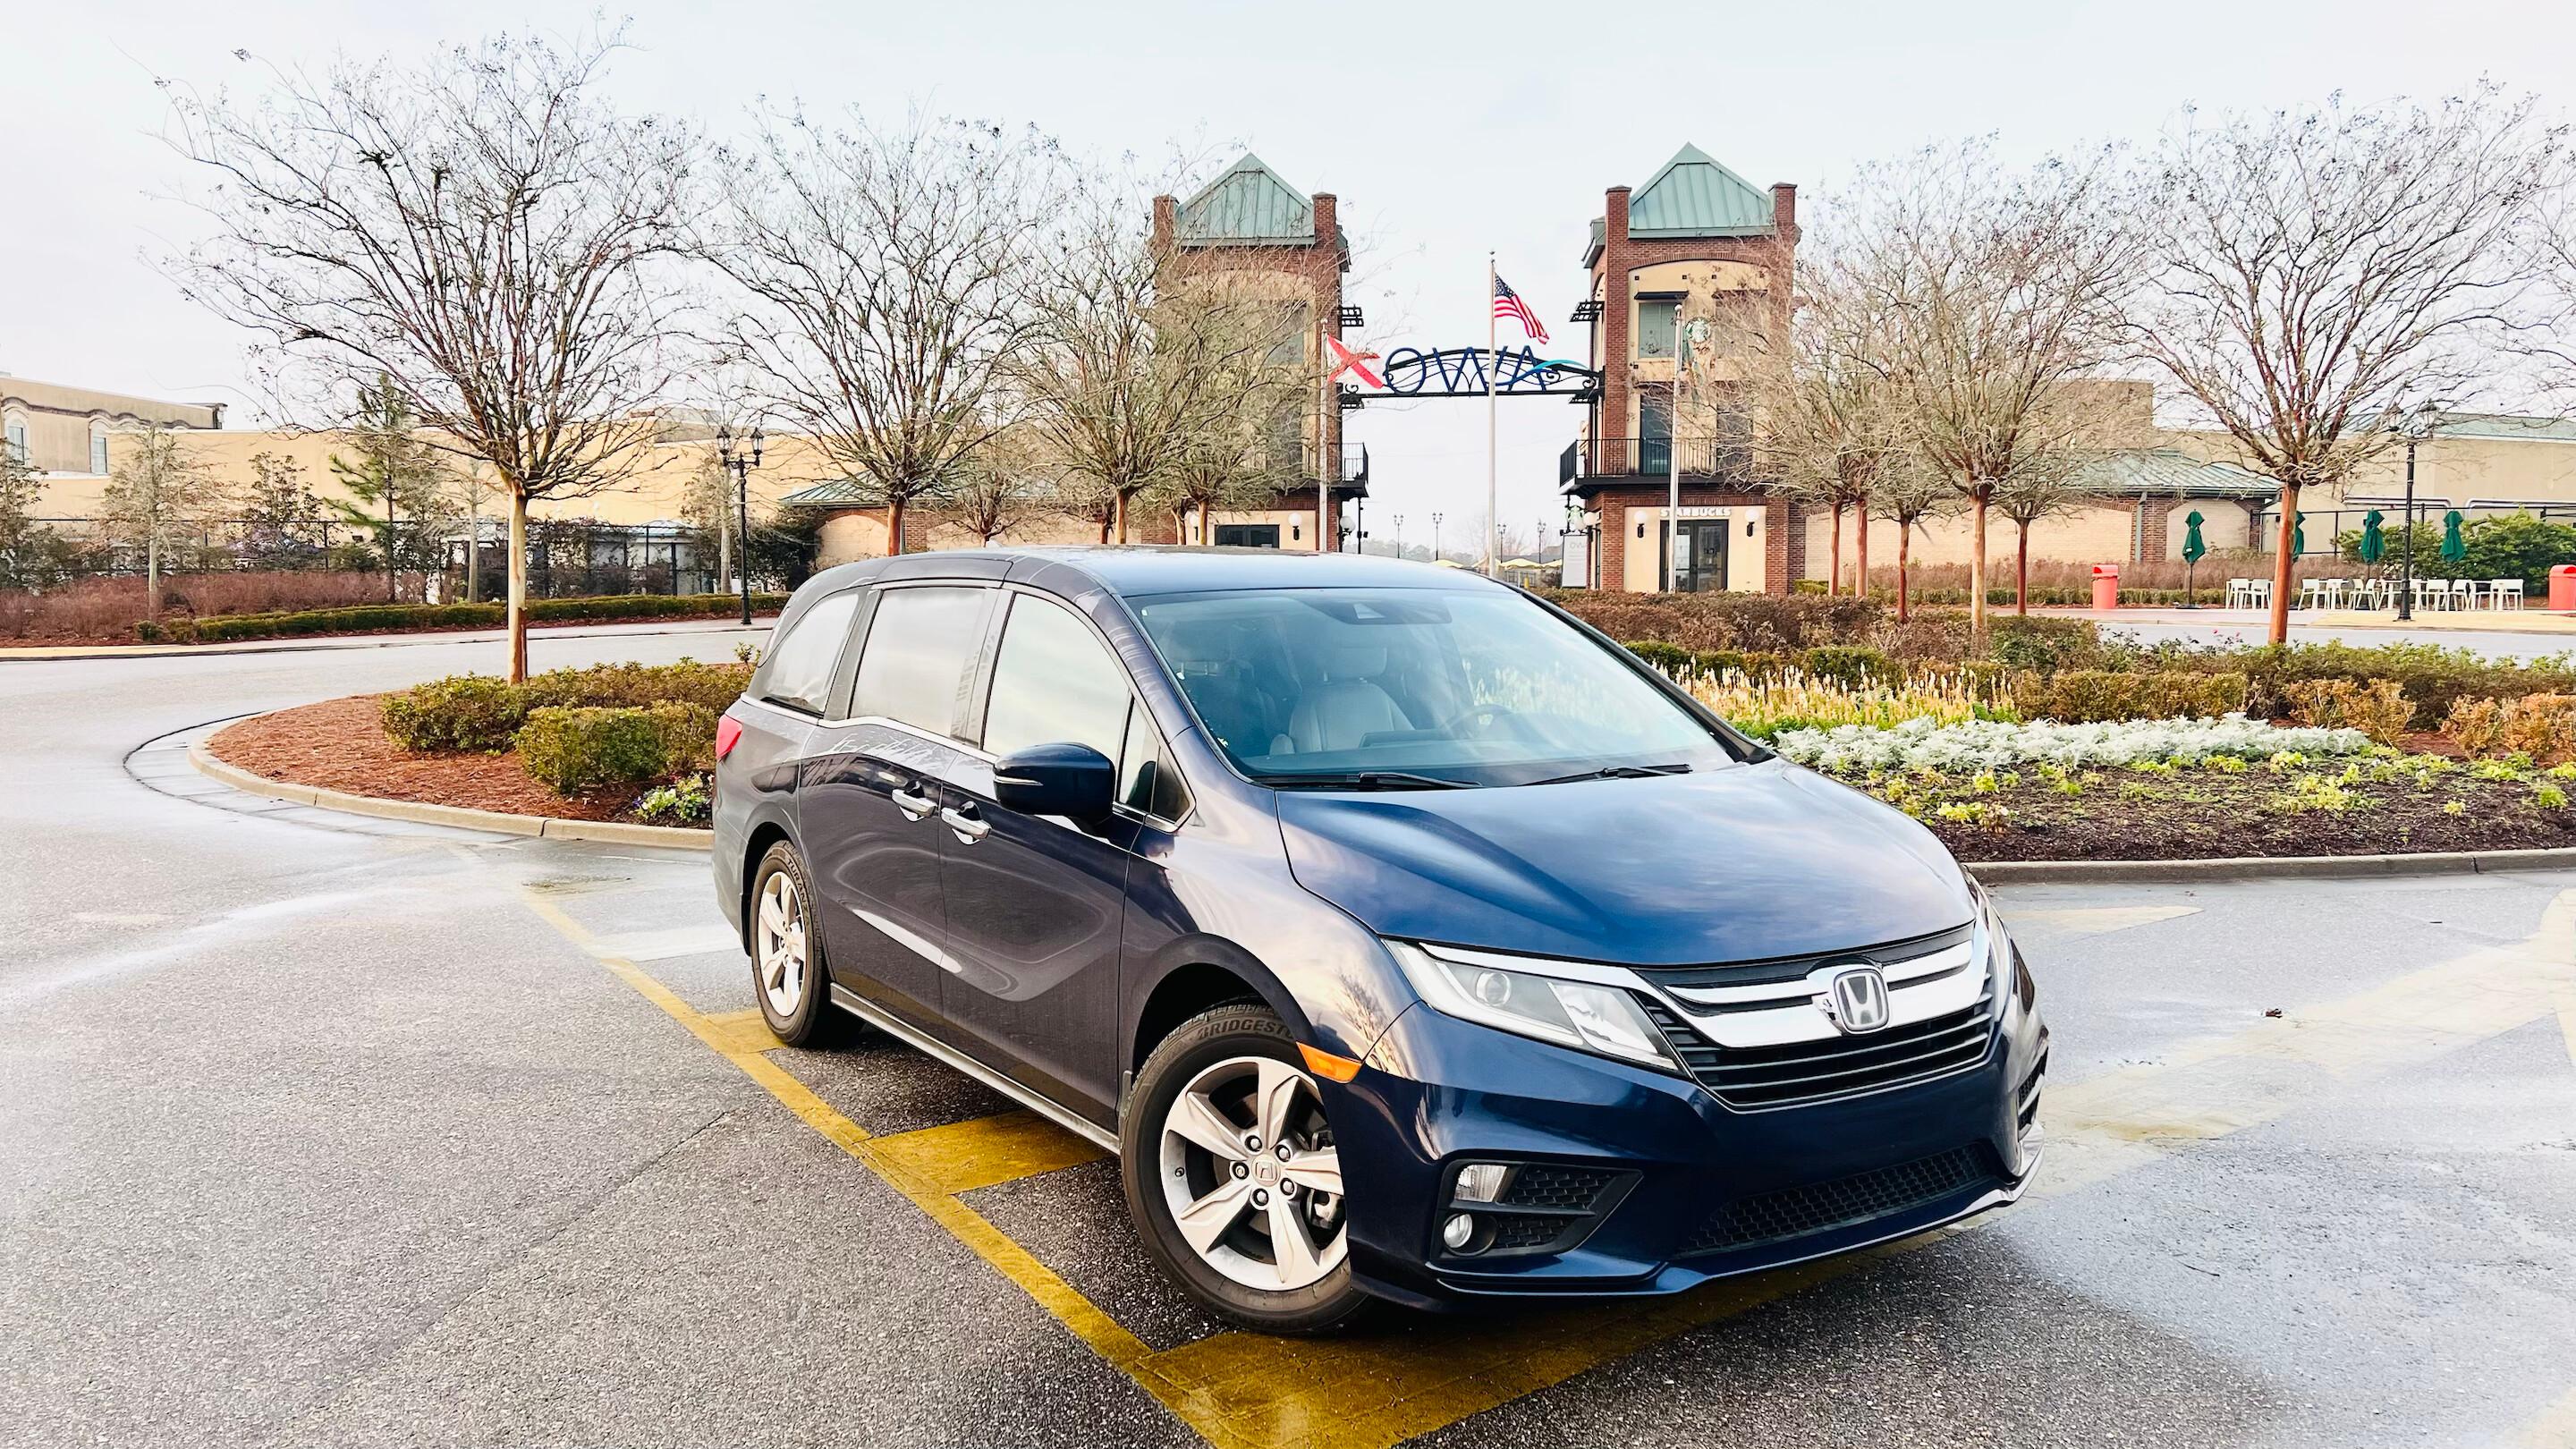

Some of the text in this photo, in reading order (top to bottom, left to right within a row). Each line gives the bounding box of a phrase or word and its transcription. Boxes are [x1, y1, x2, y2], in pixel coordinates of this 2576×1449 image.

[1385, 345, 1547, 395] OWA
[1659, 506, 1732, 517] SARBUCKS
[787, 859, 809, 926] TURANZA
